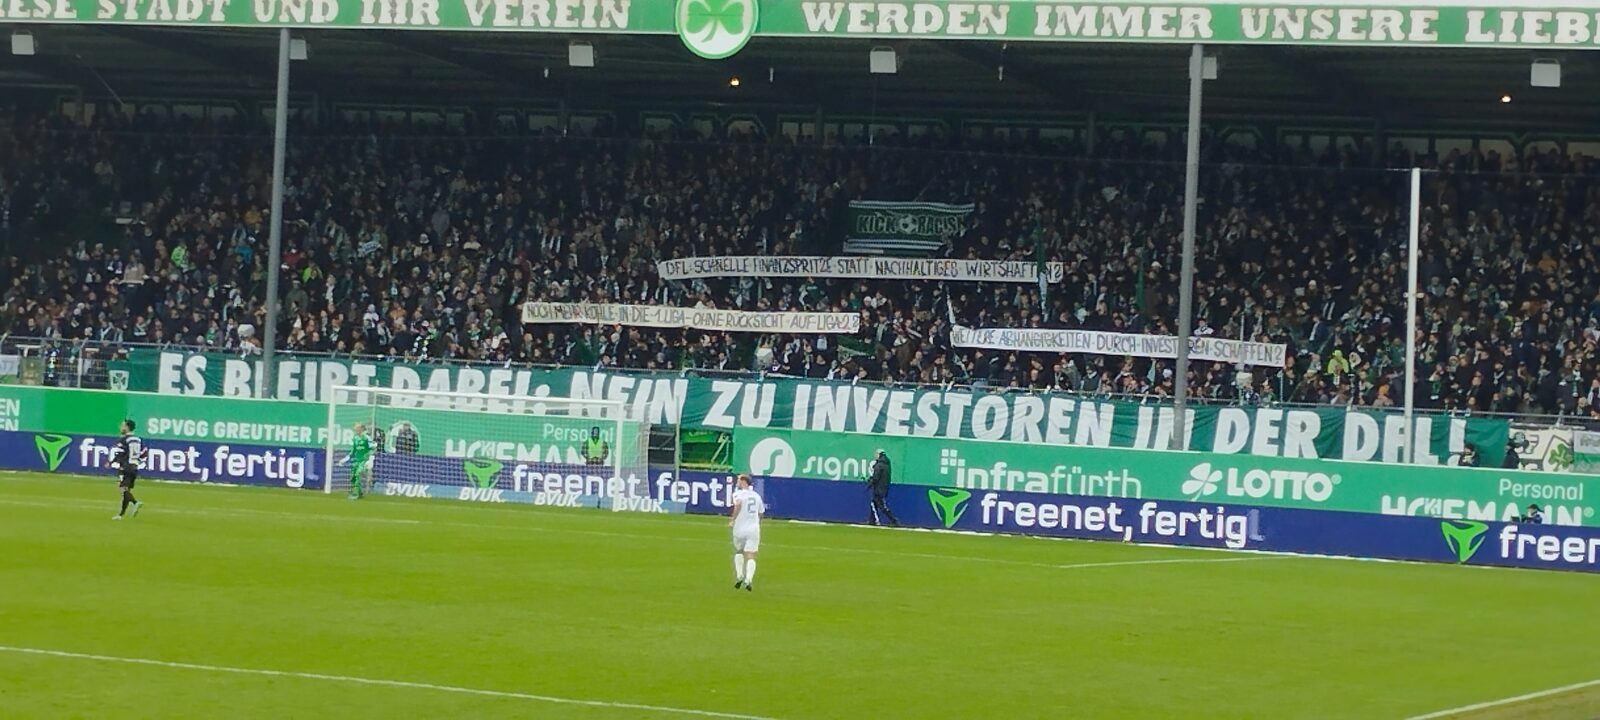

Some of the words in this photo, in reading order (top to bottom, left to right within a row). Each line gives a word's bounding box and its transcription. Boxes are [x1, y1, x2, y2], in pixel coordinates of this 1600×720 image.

[0, 0, 77, 18] ESE
[97, 0, 231, 21] STADT
[255, 0, 339, 24] UND
[361, 0, 440, 26] IHR
[463, 0, 632, 28] VEREIN
[801, 2, 1010, 35] WERDEN
[1033, 5, 1214, 39] IMMER
[1241, 7, 1439, 42] UNSERE
[857, 214, 897, 234] KICK
[693, 257, 750, 274] SCHNELLE
[837, 258, 869, 274] STATT
[632, 305, 650, 324] DIE
[692, 312, 723, 327] OHNE
[726, 312, 785, 328] RÜCKSICHT
[1096, 333, 1136, 353] DURCH
[158, 351, 208, 396] ES
[569, 371, 689, 424] NEIN
[702, 380, 776, 428] ZU
[792, 383, 1115, 448] INVESTOREN
[1132, 406, 1195, 452] IN
[1212, 408, 1321, 459] DER
[1342, 411, 1467, 467] DFL!
[147, 417, 209, 437] SPVGG
[213, 421, 311, 445] GREUTHER
[656, 472, 733, 509] ferti
[956, 459, 1142, 499] infrafürth
[1226, 468, 1333, 501] LOTTO
[1499, 477, 1584, 501] Personal
[747, 497, 757, 514] 2
[981, 492, 1133, 542] freenet,
